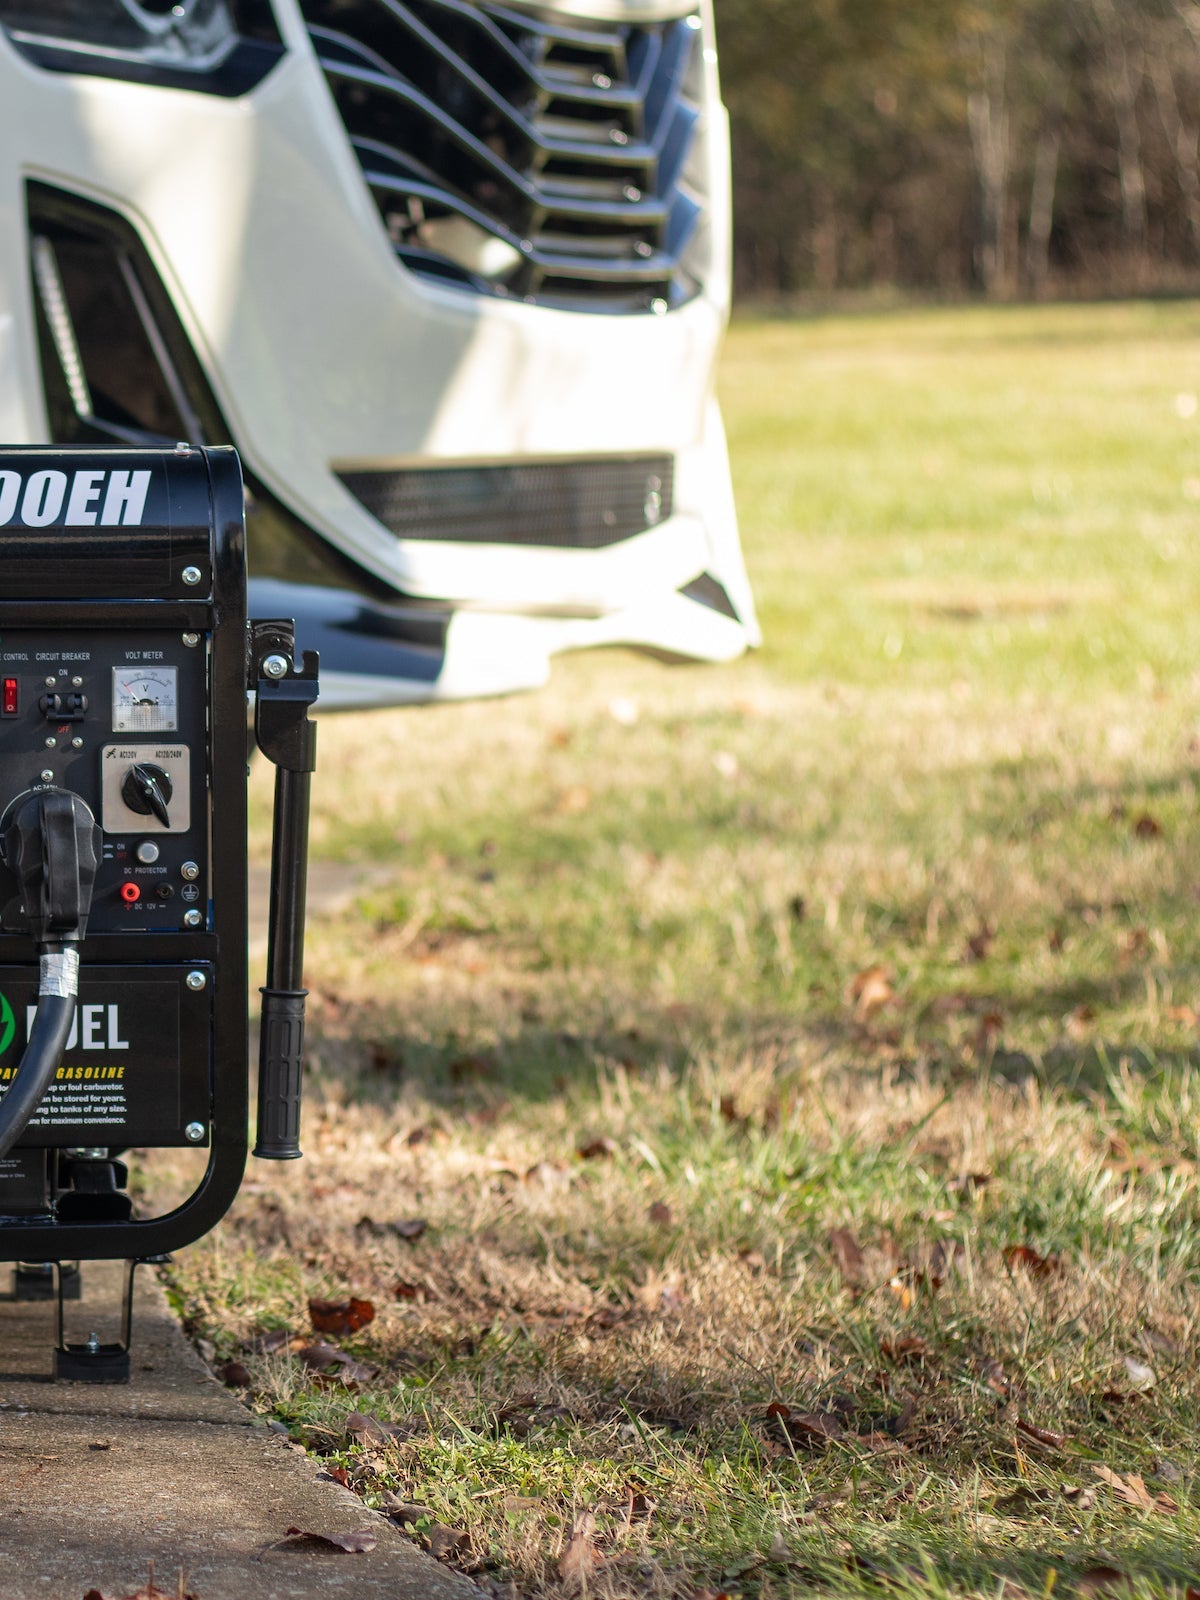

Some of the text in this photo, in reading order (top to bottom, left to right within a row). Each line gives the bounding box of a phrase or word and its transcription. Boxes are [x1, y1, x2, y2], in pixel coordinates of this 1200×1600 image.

[3, 653, 29, 661] CONTROL
[35, 652, 90, 661] CIRCUIT BREAKER
[125, 651, 165, 660] VOLT METER
[58, 668, 69, 677] ON
[142, 684, 149, 693] V
[57, 725, 70, 733] OFF
[119, 750, 137, 759] AC120V
[156, 750, 183, 759] AC120/240V
[123, 866, 168, 875] DC PROTECTOR
[134, 902, 143, 910] DC
[55, 1067, 125, 1080] GASOLINE
[68, 1083, 83, 1091] foul
[83, 1083, 125, 1091] carburetor.
[63, 1095, 89, 1103] stored
[90, 1094, 102, 1103] for
[102, 1095, 127, 1104] years.
[60, 1105, 83, 1113] tanks
[93, 1106, 109, 1115] any
[109, 1104, 128, 1113] size.
[51, 1116, 84, 1125] maximum
